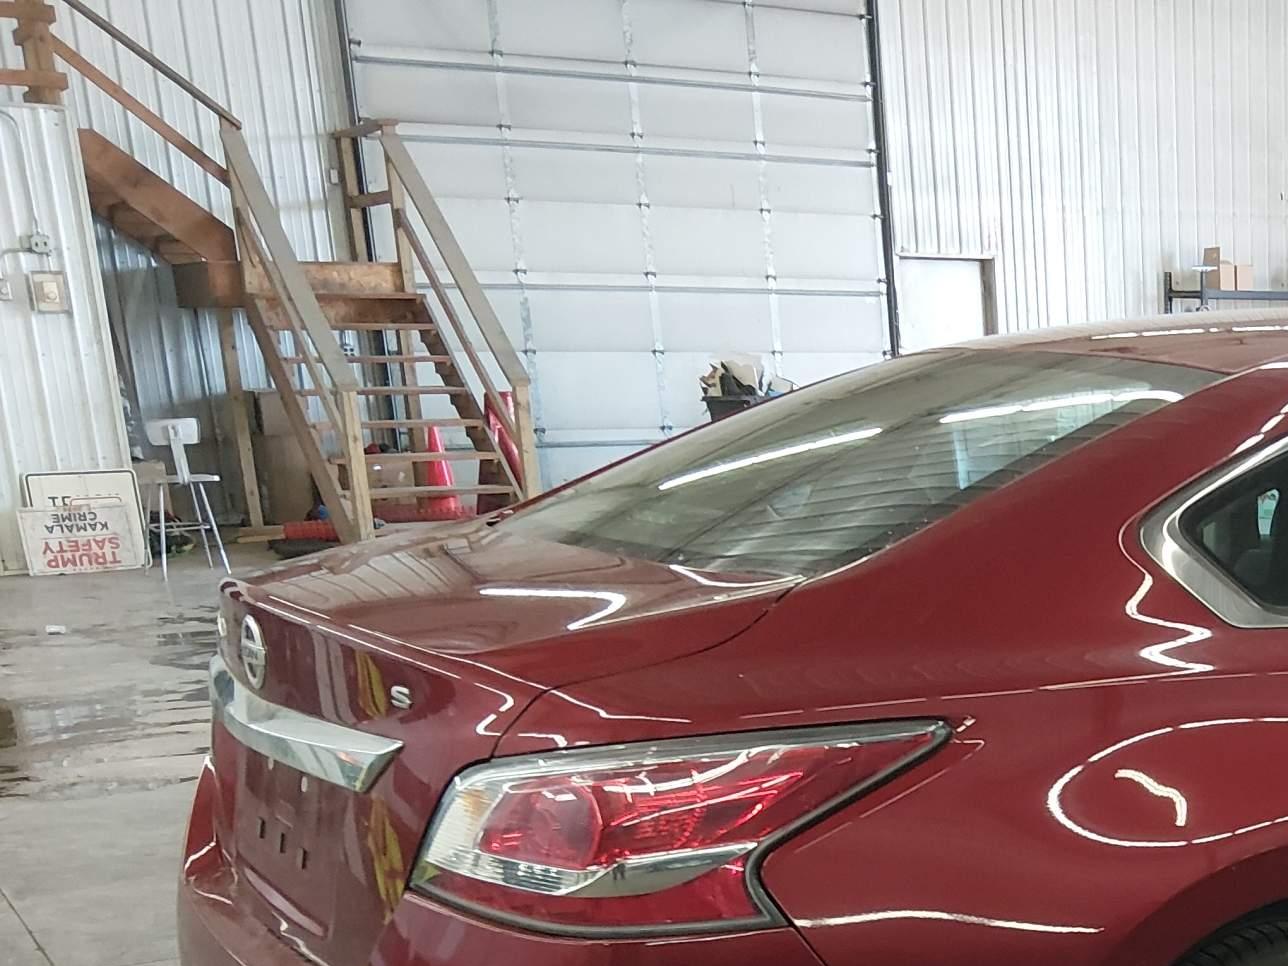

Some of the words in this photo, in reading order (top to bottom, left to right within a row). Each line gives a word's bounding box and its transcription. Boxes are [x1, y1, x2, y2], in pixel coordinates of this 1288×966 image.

[51, 511, 98, 524] CRIME
[44, 521, 109, 534] KAMALA
[42, 536, 121, 556] SAFETY
[46, 551, 122, 569] TRUMP
[390, 686, 412, 709] S
